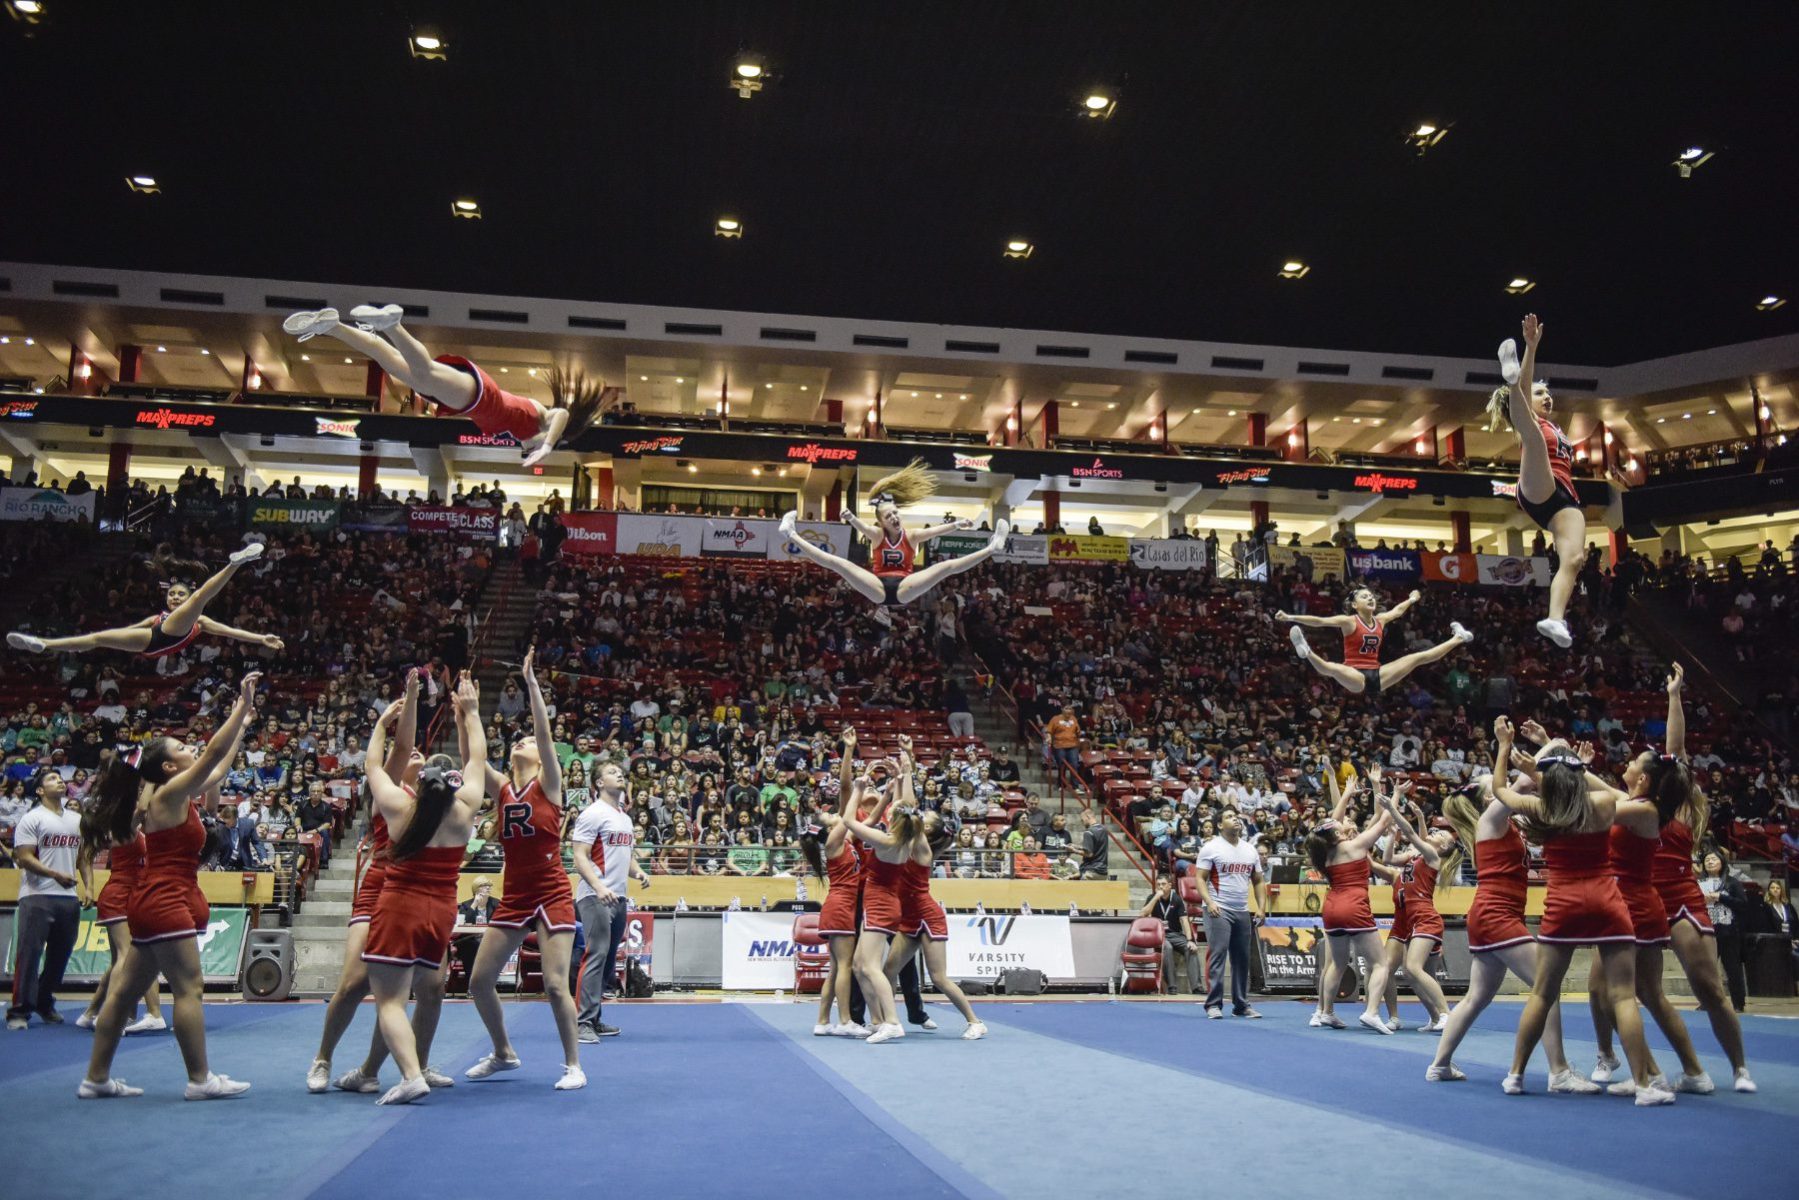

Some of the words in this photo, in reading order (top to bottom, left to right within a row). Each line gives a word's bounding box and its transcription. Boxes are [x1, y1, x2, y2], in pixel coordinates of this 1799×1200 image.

[136, 408, 215, 428] MAXPREPS
[320, 422, 356, 434] SONIC
[460, 434, 480, 444] BSN
[787, 443, 858, 463] MAXPREPS
[956, 456, 989, 467] SONIC
[1073, 467, 1093, 477] BSN
[1093, 469, 1123, 479] SPORTS
[1354, 473, 1418, 493] MAXPREPS
[1495, 485, 1517, 494] SON
[4, 503, 29, 513] RIO
[31, 503, 88, 516] RANCHO
[252, 507, 335, 524] SUBWAY
[411, 511, 459, 522] COMPETE
[460, 513, 495, 529] CLASS
[713, 529, 744, 539] NMAA
[1147, 543, 1171, 562] Casas
[1173, 545, 1187, 562] del
[1439, 556, 1460, 579] G
[1360, 634, 1380, 654] R
[503, 803, 535, 838] R
[43, 834, 80, 847] LOBOS
[1221, 863, 1252, 873] LOBOS
[968, 952, 1026, 962] VARSITY
[1266, 954, 1288, 965] RISE
[1288, 955, 1304, 965] TO
[1268, 965, 1278, 974] In
[1279, 965, 1294, 974] the
[1296, 965, 1316, 975] Arm
